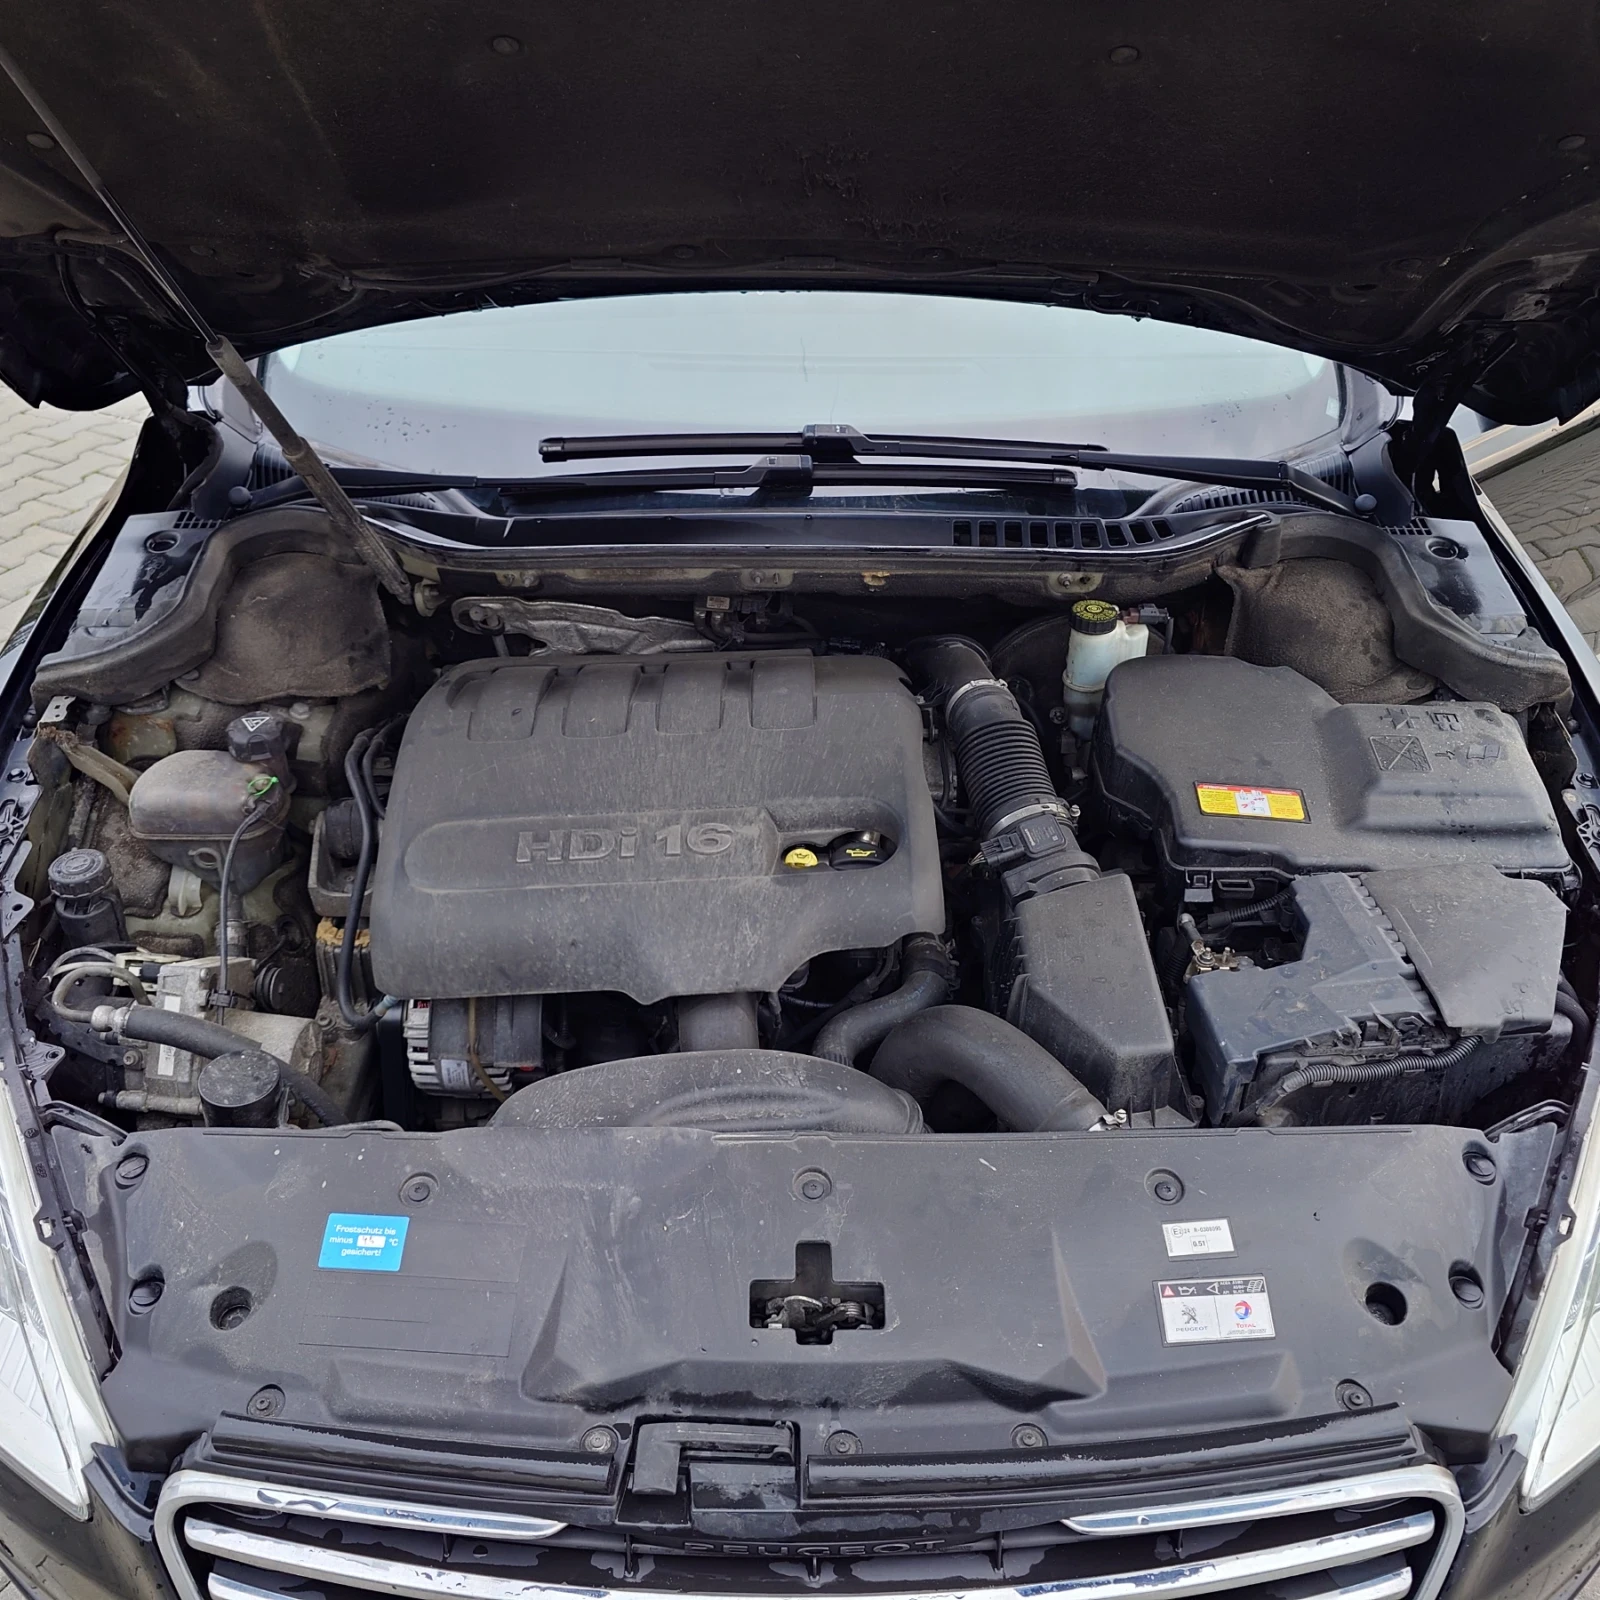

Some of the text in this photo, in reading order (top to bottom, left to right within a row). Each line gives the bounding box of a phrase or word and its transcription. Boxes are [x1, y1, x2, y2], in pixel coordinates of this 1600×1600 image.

[516, 822, 735, 863] HDi 16
[335, 1224, 396, 1236] Frostschutz bis
[329, 1235, 353, 1244] minus
[340, 1247, 382, 1257] gesichert!
[685, 1540, 945, 1555] PEUGEOT
